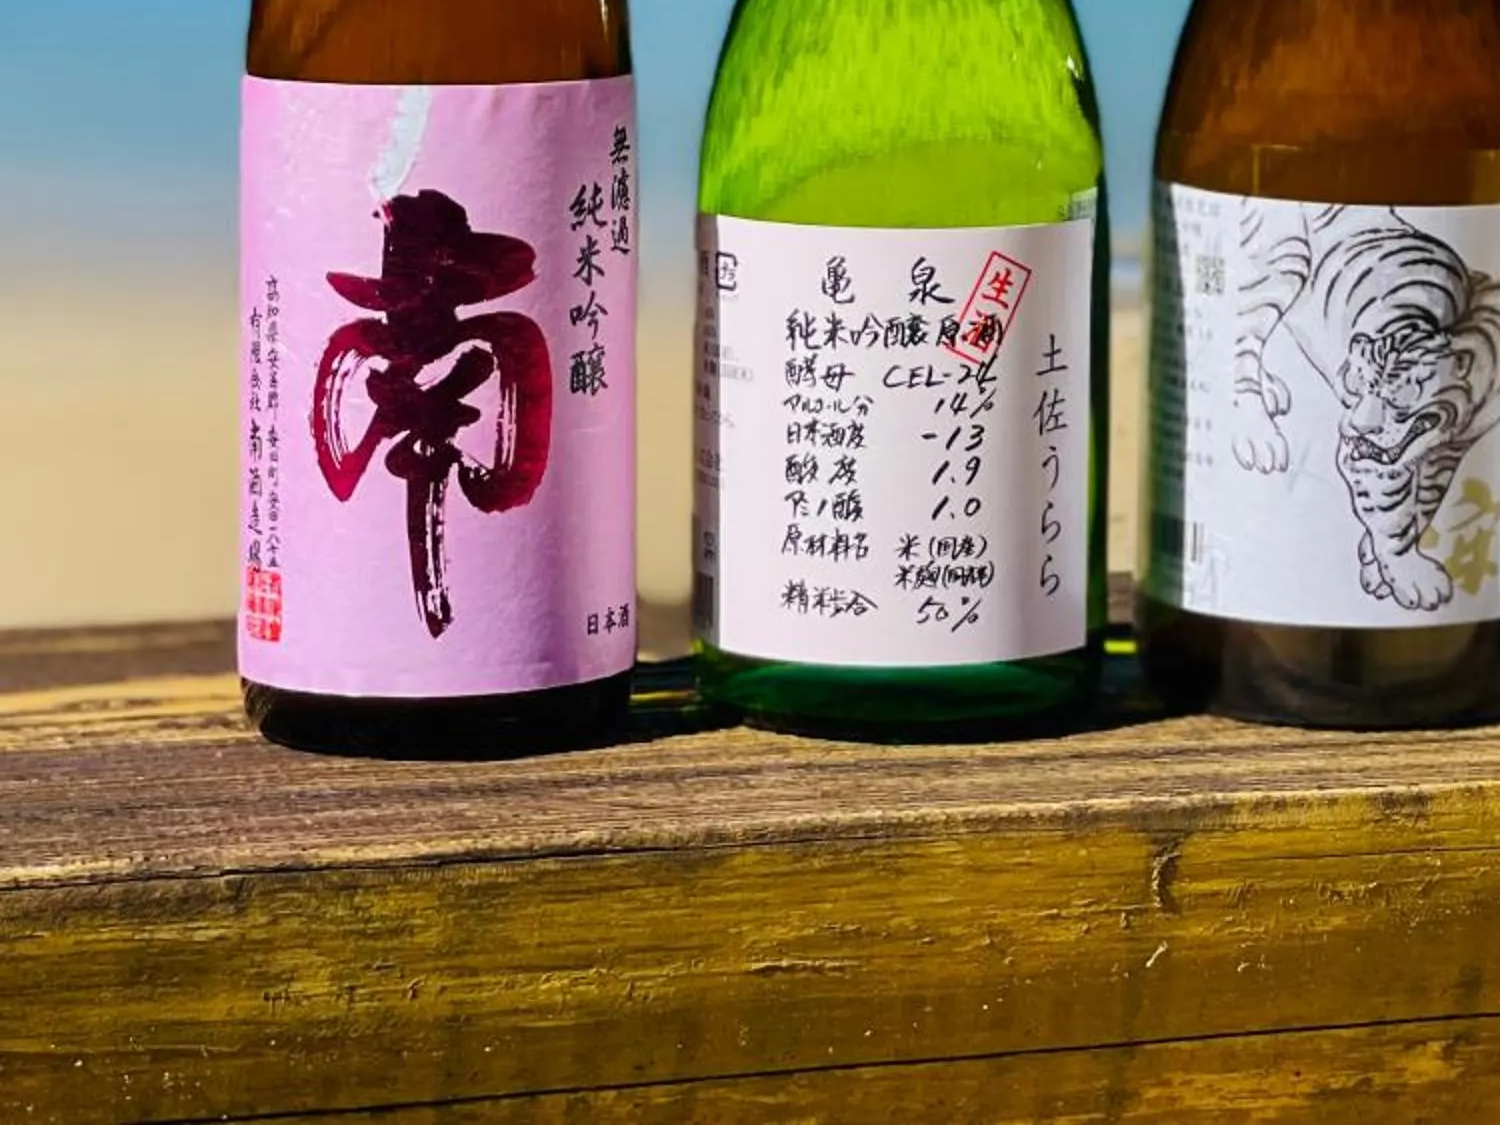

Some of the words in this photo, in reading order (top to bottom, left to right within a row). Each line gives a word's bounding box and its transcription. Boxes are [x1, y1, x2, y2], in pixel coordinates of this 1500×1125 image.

[569, 181, 608, 397] 純米吟醸
[960, 268, 1018, 353] 生酒
[784, 352, 854, 392] 酵母
[933, 386, 998, 419] 14%
[920, 424, 986, 452] -13
[930, 455, 982, 486] 1.9
[1033, 332, 1070, 597] 土佐うらら
[930, 495, 982, 521] 1.0
[587, 602, 629, 635] 日本酒
[915, 595, 983, 633] 50%
